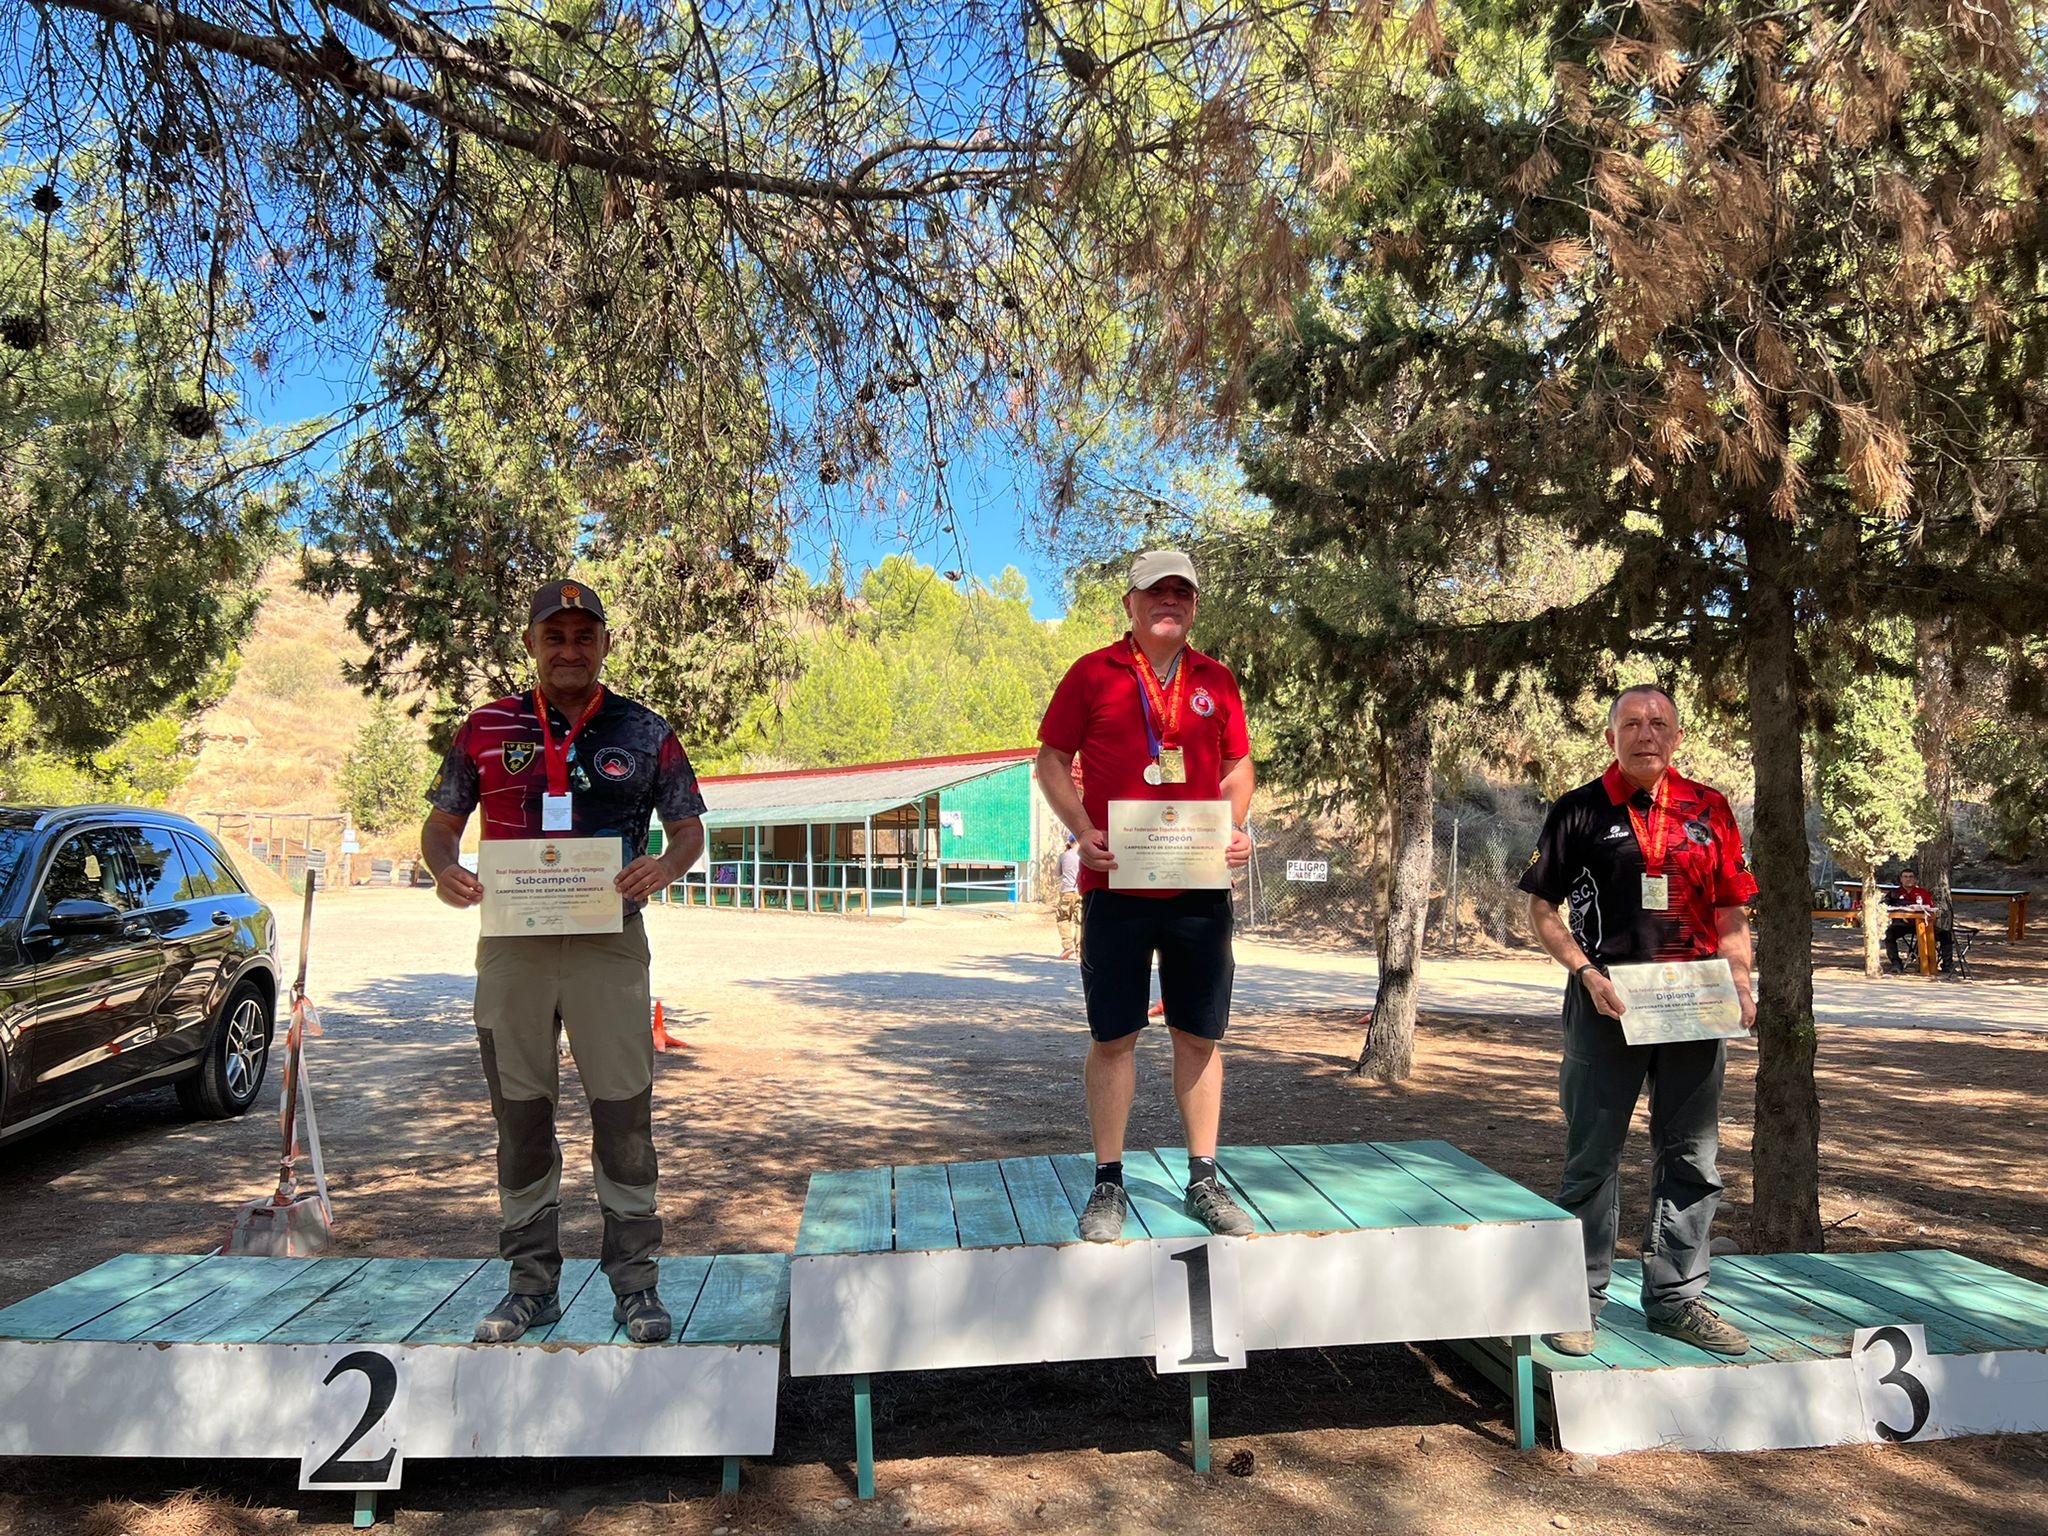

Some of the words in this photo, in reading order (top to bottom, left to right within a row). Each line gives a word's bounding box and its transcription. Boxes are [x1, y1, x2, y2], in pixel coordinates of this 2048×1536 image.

[1147, 833, 1193, 844] Campeón
[1288, 862, 1326, 872] PELIGRO
[515, 874, 586, 886] Subcampeón
[1656, 991, 1696, 1001] Diploma
[1170, 1243, 1229, 1365] 1
[1862, 1326, 1930, 1442] 3
[309, 1351, 397, 1483] 2
